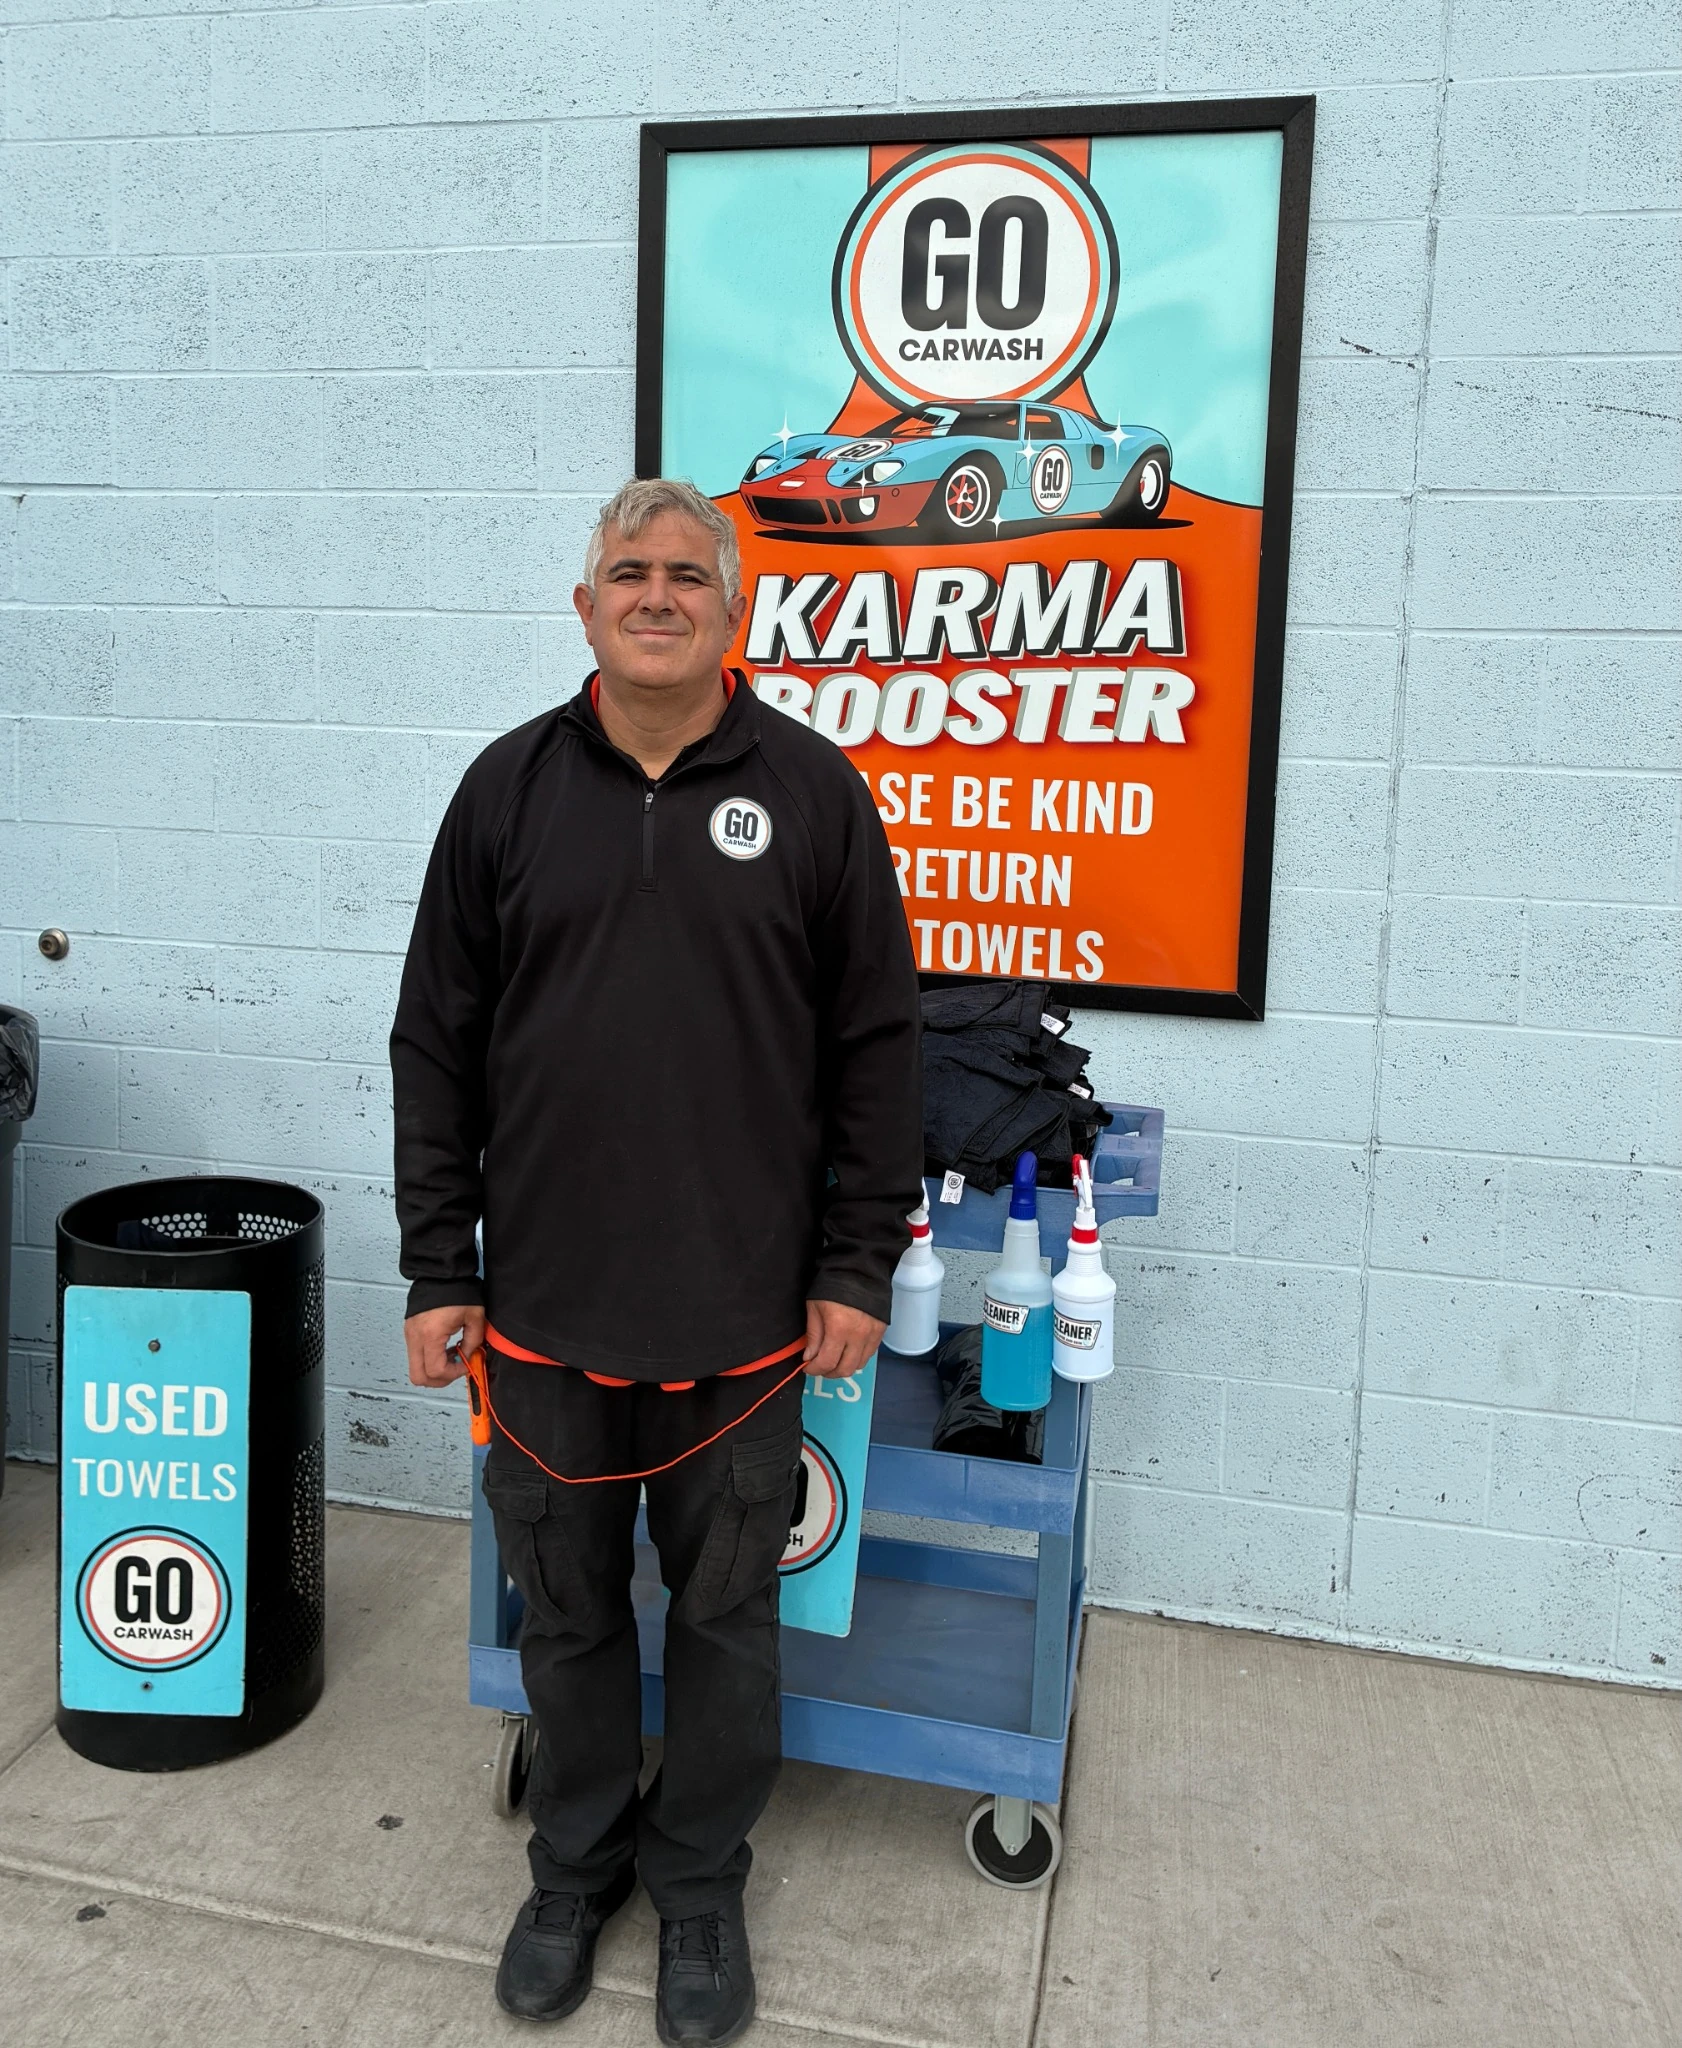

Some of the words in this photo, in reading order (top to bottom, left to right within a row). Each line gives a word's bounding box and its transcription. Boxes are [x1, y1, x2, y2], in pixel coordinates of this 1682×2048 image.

[901, 195, 1049, 332] GO
[899, 338, 1043, 362] CARWASH
[838, 444, 883, 458] GO
[1041, 458, 1064, 491] GO
[743, 559, 1187, 666] KARMA
[753, 667, 1195, 747] BOOSTER
[724, 807, 759, 842] GO
[951, 775, 1013, 830] BE
[1030, 778, 1154, 835] KIND
[723, 838, 757, 849] CARWASH
[890, 846, 1073, 907] RETURN
[913, 918, 1105, 982] TOWELS
[84, 1382, 228, 1437] USED
[71, 1457, 237, 1502] TOWELS
[115, 1555, 193, 1625] GO
[113, 1626, 193, 1640] CARWASH
